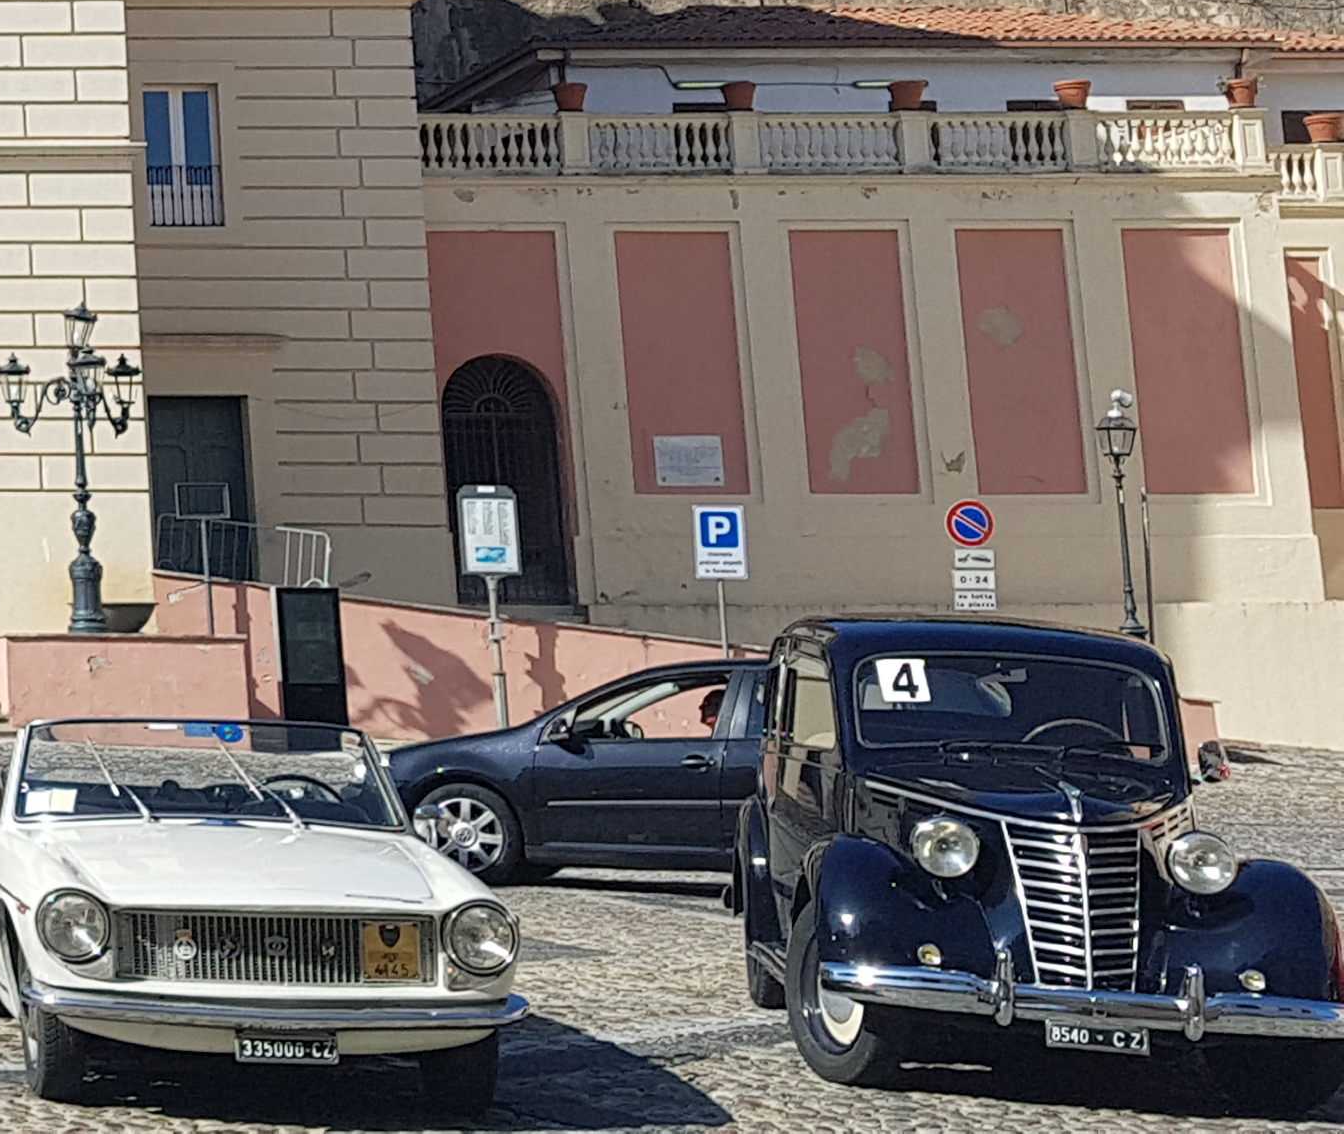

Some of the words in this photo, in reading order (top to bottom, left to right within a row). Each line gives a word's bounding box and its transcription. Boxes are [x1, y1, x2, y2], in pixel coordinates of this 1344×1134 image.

[707, 515, 731, 545] P
[892, 662, 919, 699] 4
[1051, 1026, 1089, 1044] 8540
